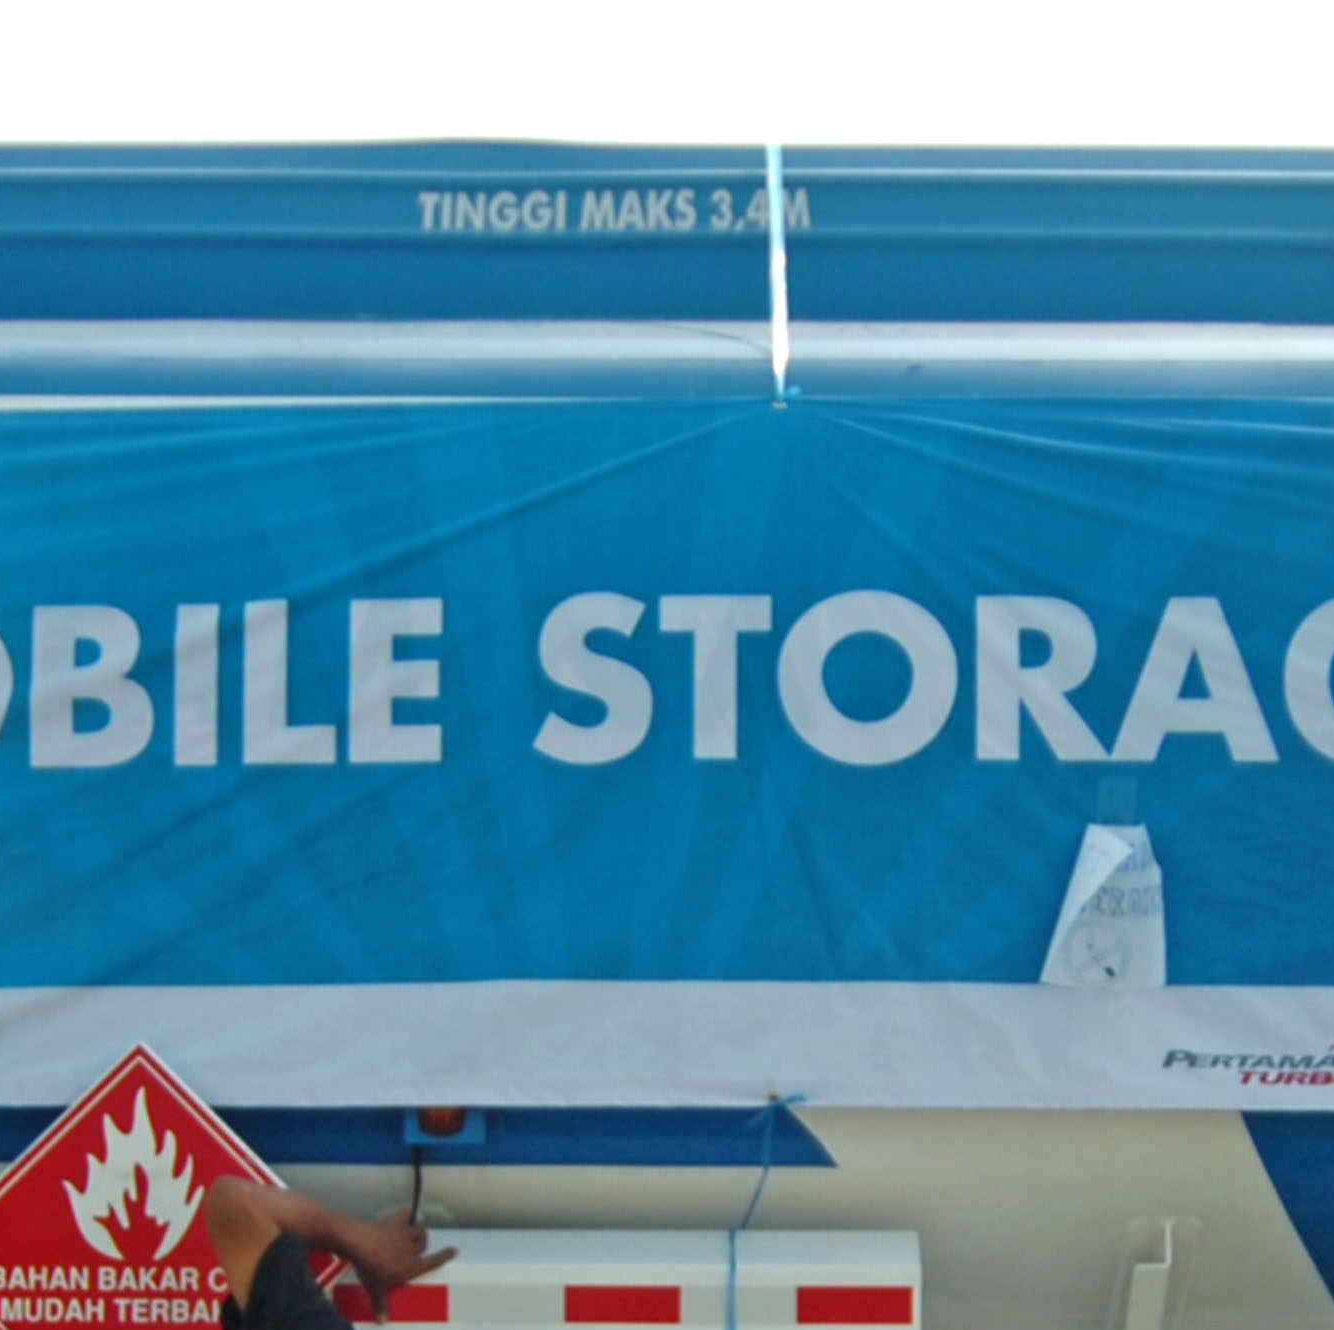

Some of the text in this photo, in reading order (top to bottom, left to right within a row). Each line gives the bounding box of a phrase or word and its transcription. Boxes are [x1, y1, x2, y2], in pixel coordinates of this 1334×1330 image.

[419, 191, 566, 231] TINGGI
[580, 189, 696, 231] MAKS
[97, 1266, 200, 1292] BAKAR
[0, 1297, 106, 1323] MUDAH
